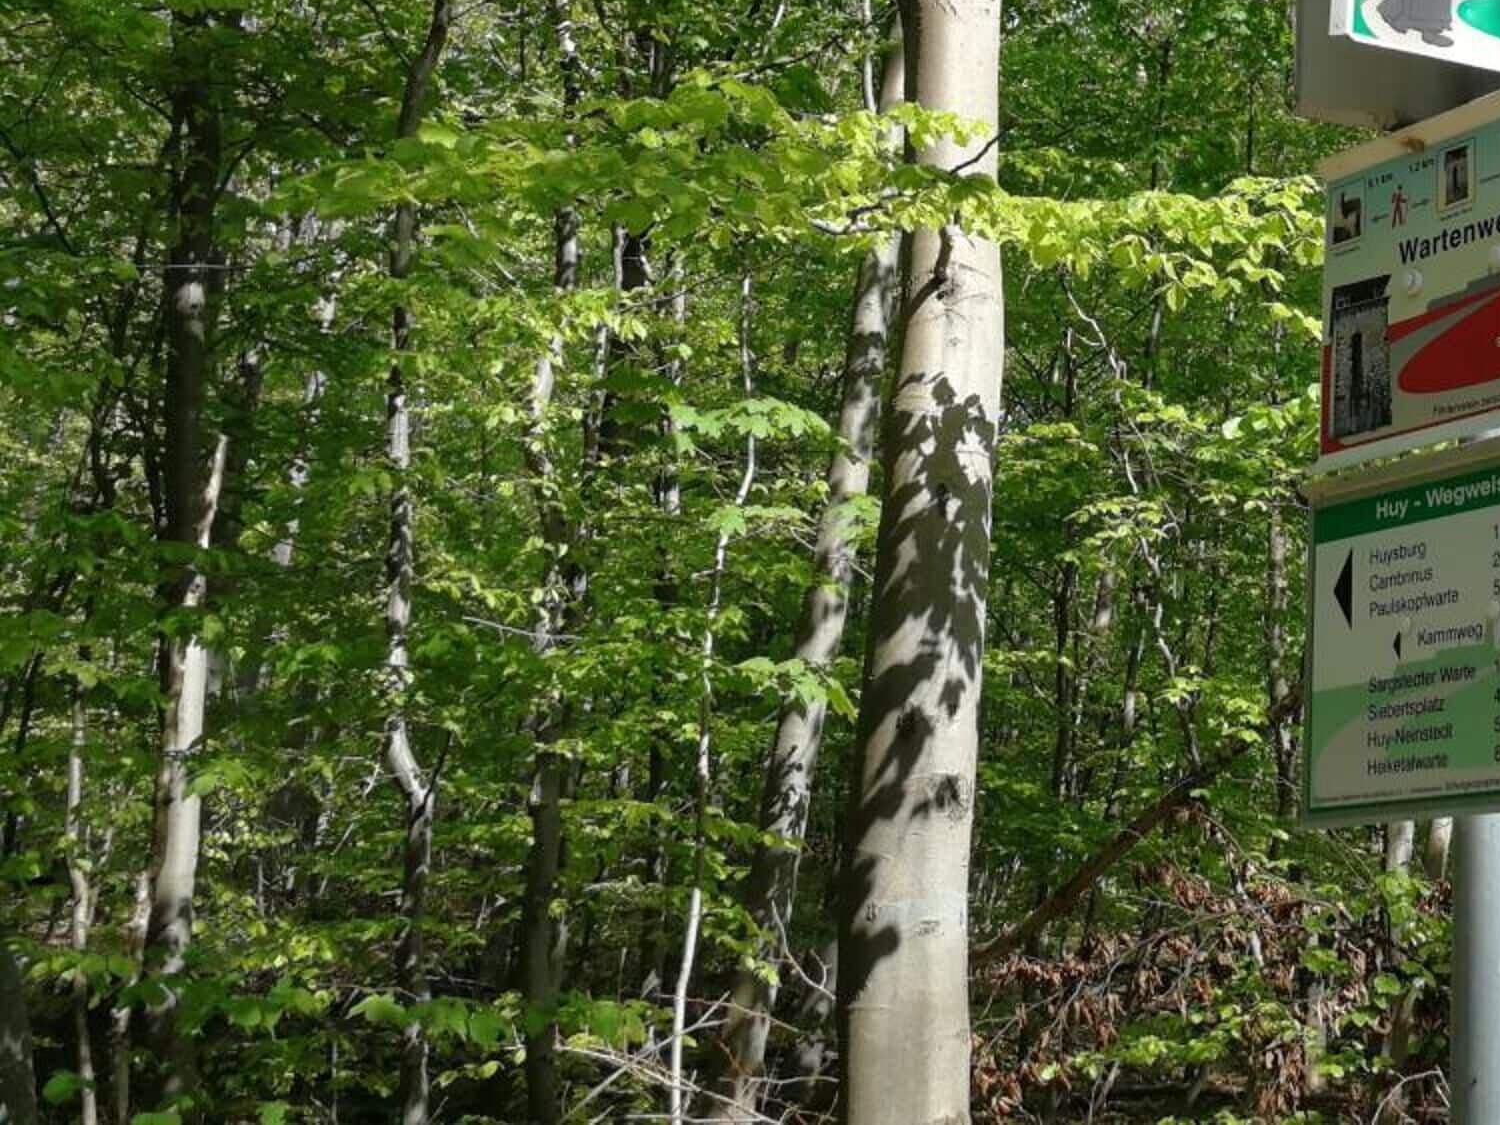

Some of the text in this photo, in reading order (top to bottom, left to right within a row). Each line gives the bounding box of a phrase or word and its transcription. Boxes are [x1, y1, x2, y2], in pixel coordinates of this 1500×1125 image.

[1375, 496, 1409, 520] Huy
[1369, 541, 1427, 565] Huysburg
[1416, 621, 1484, 648] Kammweg
[1439, 665, 1476, 683] Warte
